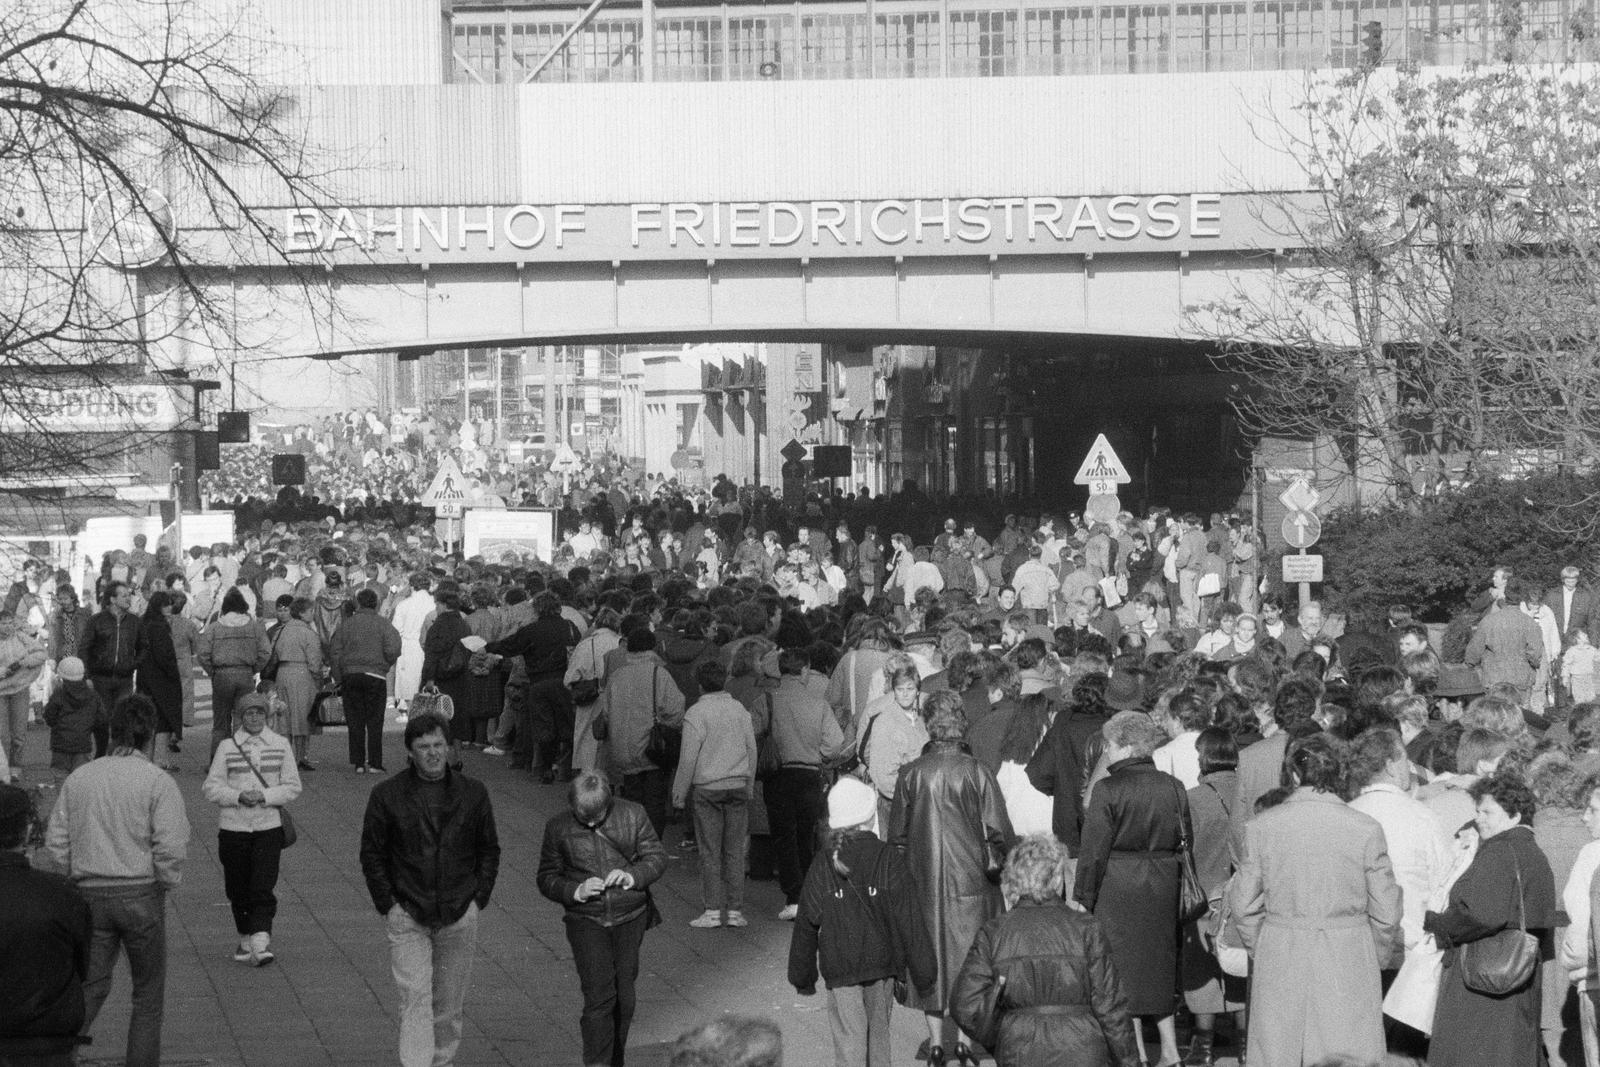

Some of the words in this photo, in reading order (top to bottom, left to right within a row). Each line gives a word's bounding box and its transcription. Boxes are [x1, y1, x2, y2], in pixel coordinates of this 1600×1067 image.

[285, 204, 587, 252] BAHNHOF
[630, 193, 1222, 247] FRIEDRICHSTRASSE
[1096, 482, 1108, 491] 50
[442, 504, 454, 514] 50
